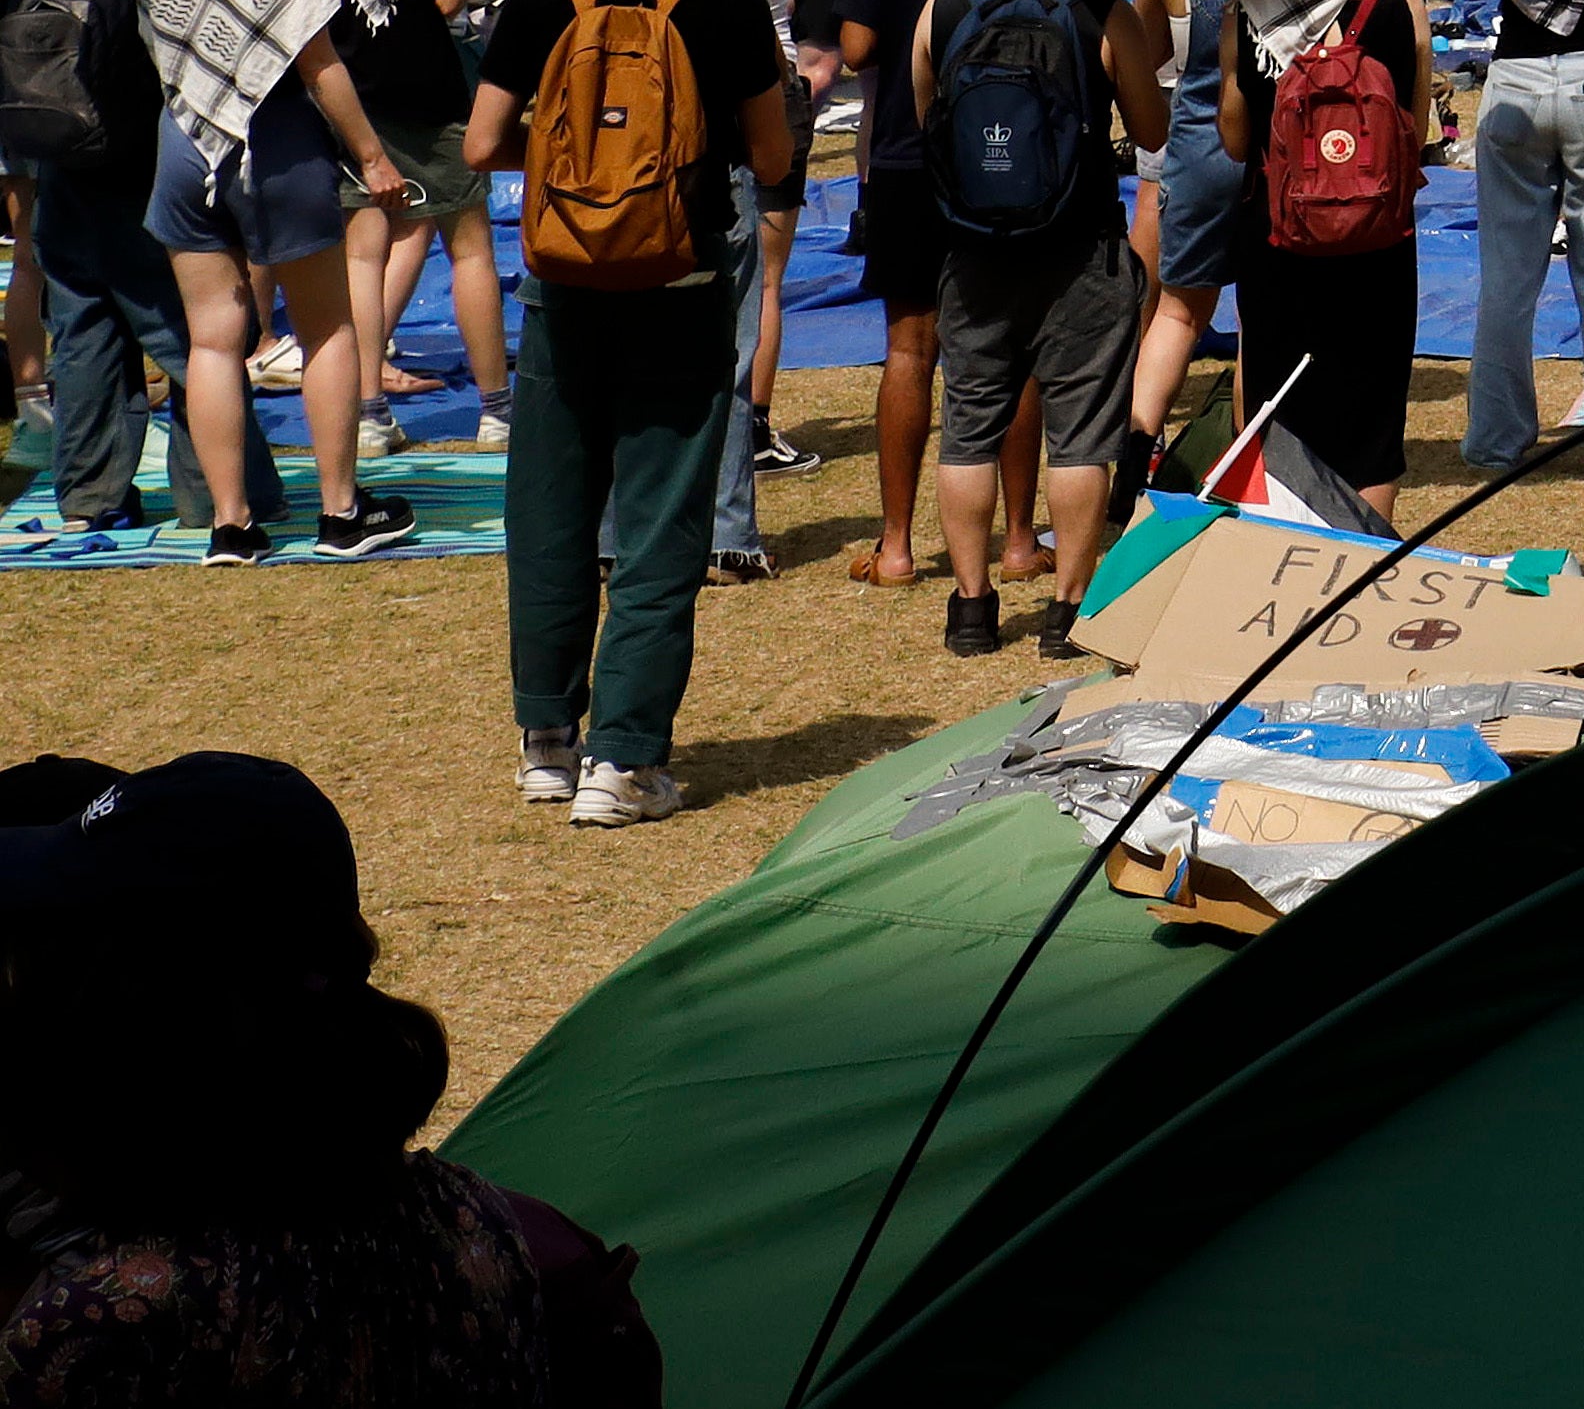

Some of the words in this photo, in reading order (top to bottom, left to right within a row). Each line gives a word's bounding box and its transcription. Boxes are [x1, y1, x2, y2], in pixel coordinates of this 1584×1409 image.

[984, 147, 1010, 159] SIPA
[1271, 544, 1506, 609] FIRST
[1238, 600, 1362, 647] AID
[1223, 798, 1299, 843] NO
